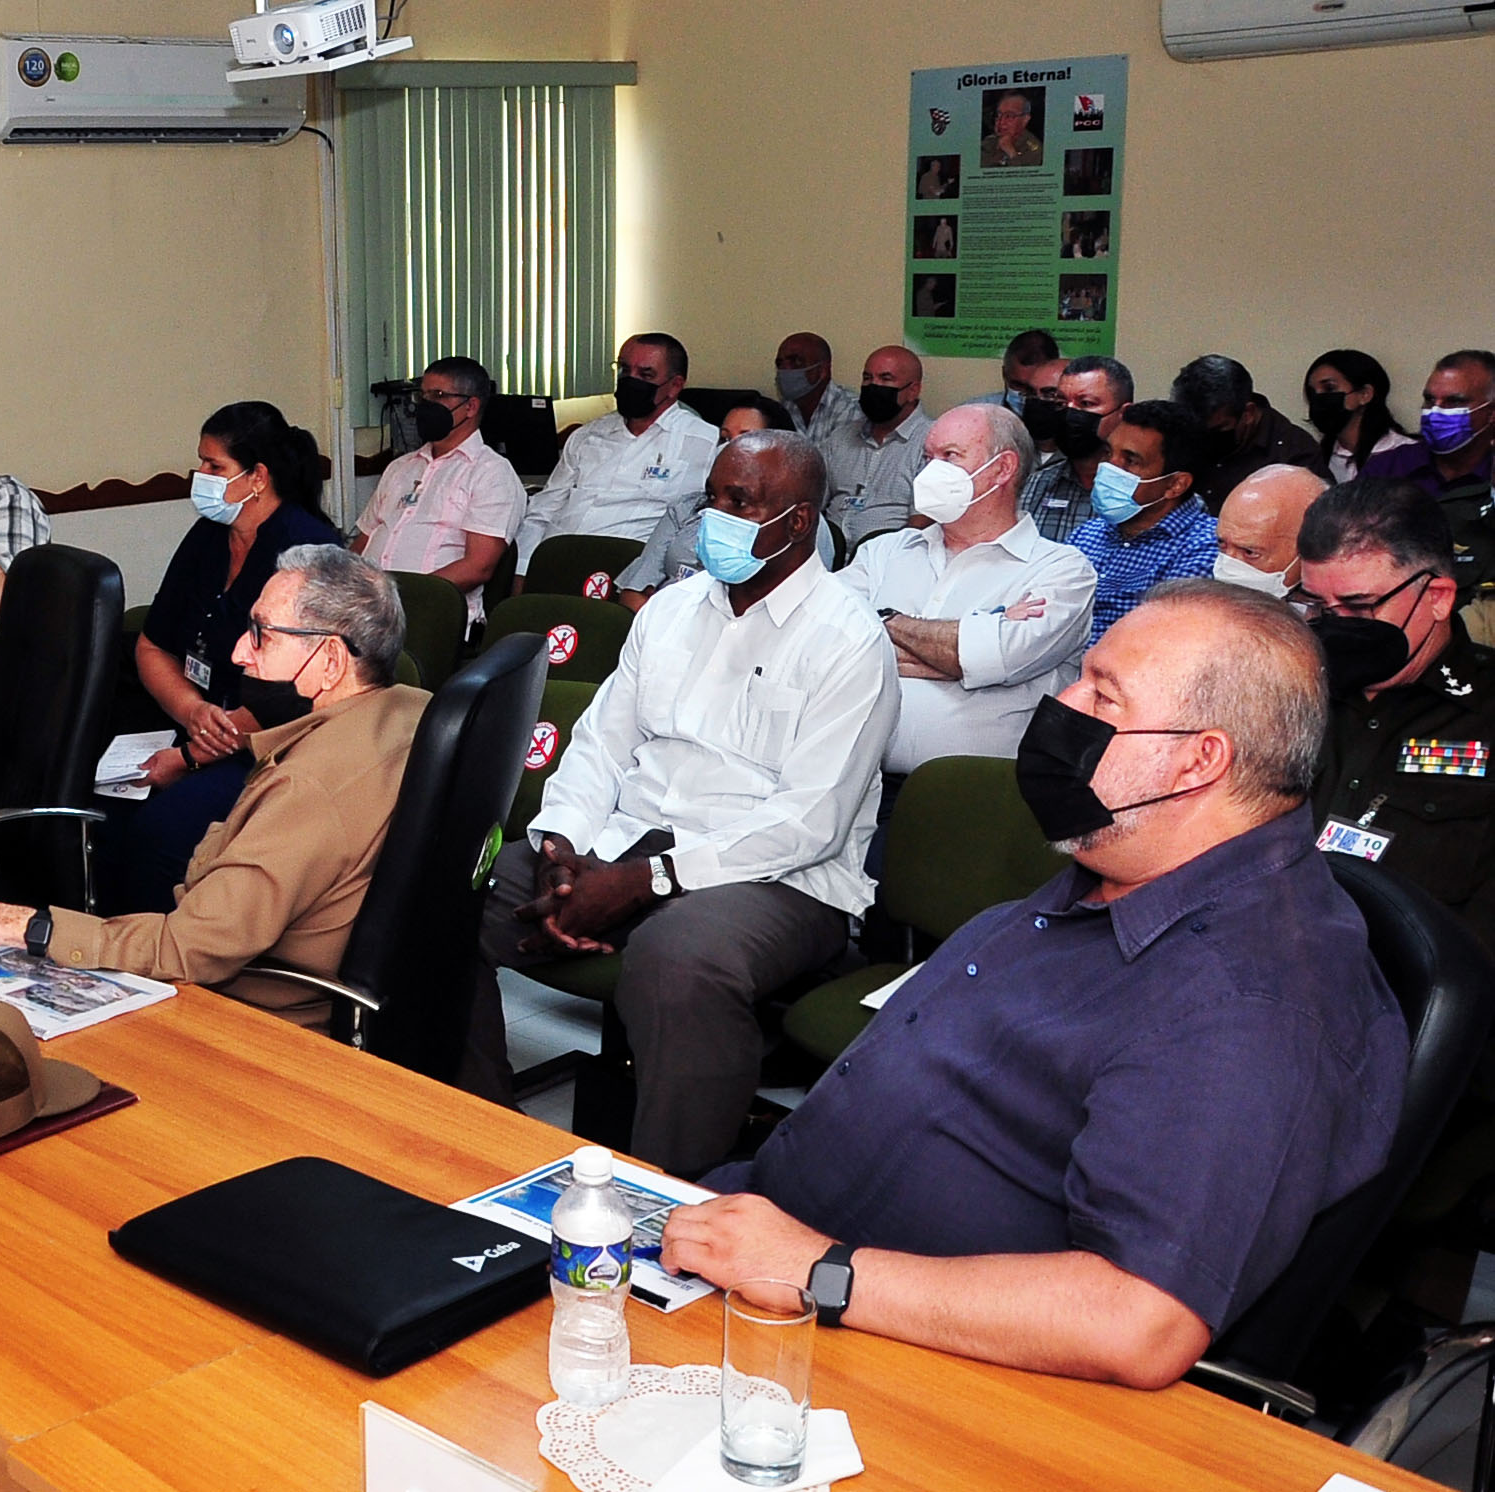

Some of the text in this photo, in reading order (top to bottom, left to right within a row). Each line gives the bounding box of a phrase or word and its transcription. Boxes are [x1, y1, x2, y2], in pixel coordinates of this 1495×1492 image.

[25, 60, 45, 71] 120
[957, 67, 1072, 90] ¡Gloria Eterna!
[1363, 837, 1383, 850] 10
[483, 1242, 521, 1258] Cuba
